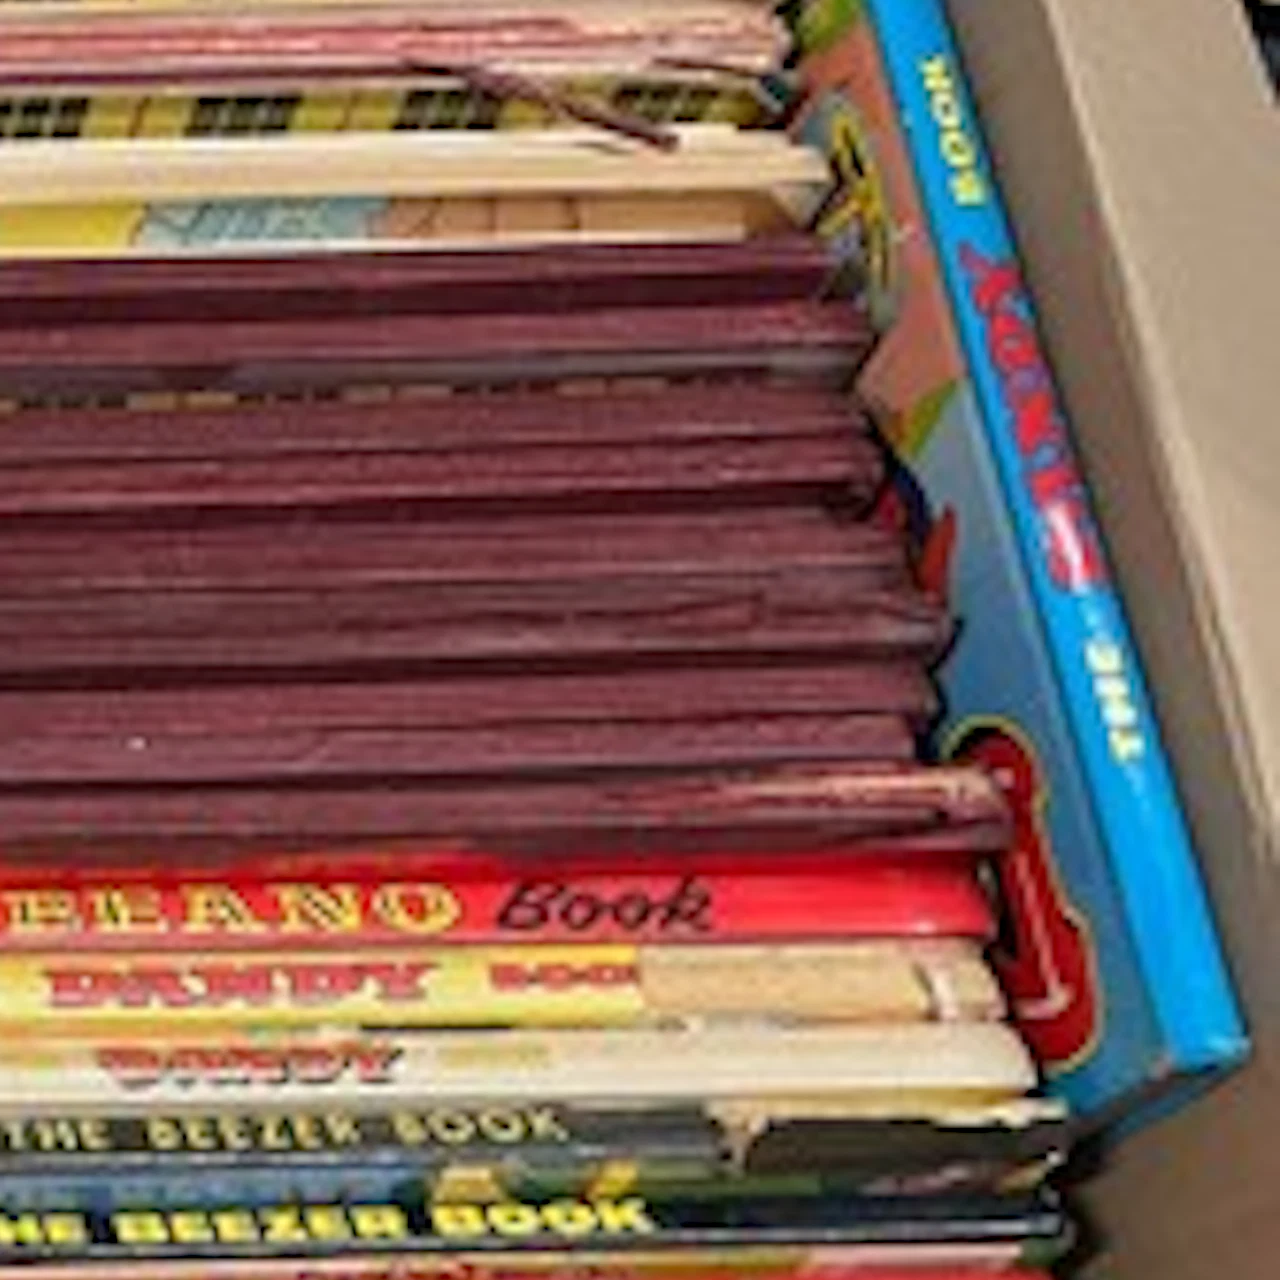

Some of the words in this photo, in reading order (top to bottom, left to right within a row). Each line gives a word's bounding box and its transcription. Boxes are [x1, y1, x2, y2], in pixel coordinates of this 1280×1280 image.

[918, 54, 987, 207] BOOK
[960, 244, 1104, 592] DANDY
[1087, 637, 1146, 764] THE
[495, 874, 714, 934] Book
[43, 962, 441, 1009] DANDY
[490, 962, 638, 992] BOO
[6, 1120, 113, 1151] THE
[148, 1115, 362, 1151] BEEZER
[394, 1105, 570, 1146] BOOK
[110, 1204, 407, 1246] BEEZER
[430, 1198, 655, 1238] BOOK
